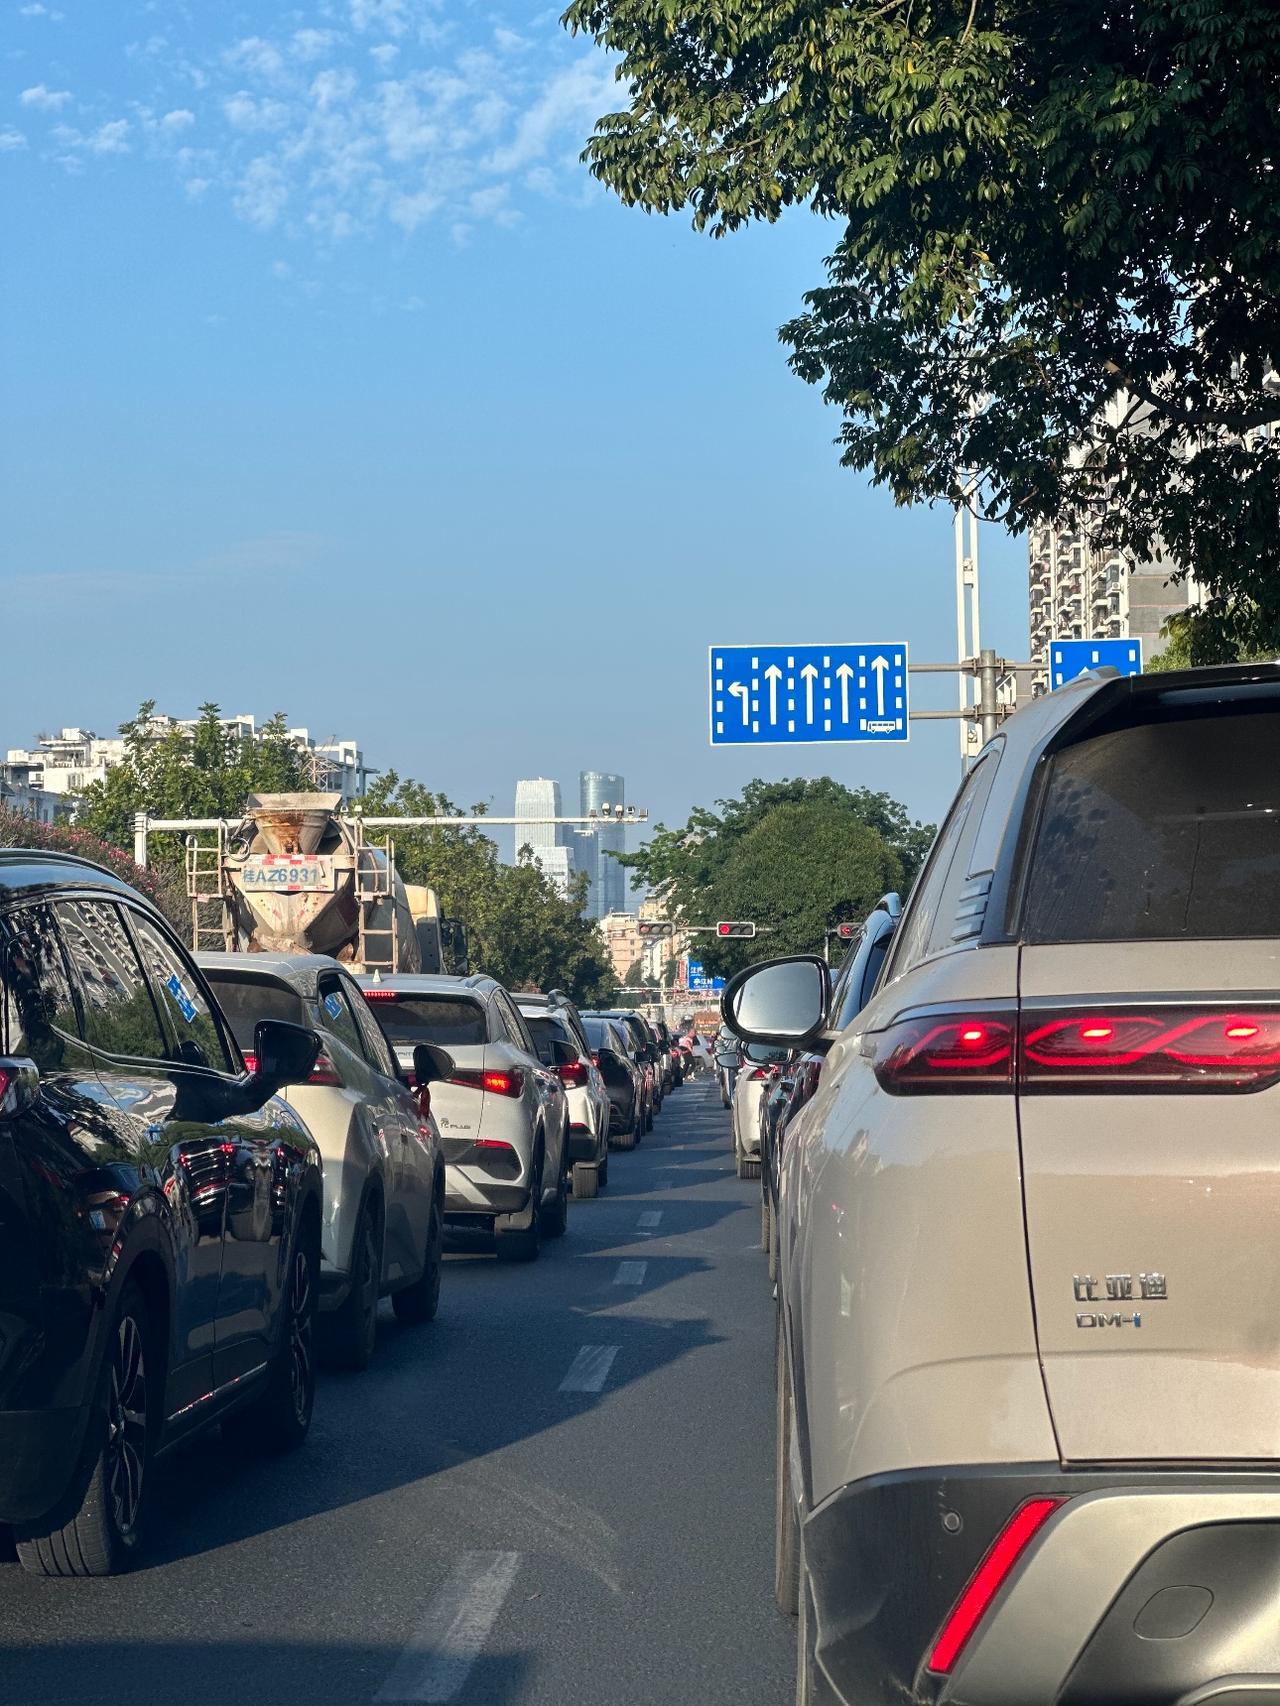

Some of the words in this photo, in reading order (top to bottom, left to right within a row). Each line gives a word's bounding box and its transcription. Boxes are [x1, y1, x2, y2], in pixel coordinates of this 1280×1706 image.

[243, 868, 319, 883] 桂AZ6931
[1073, 1272, 1168, 1301] 比亚迪
